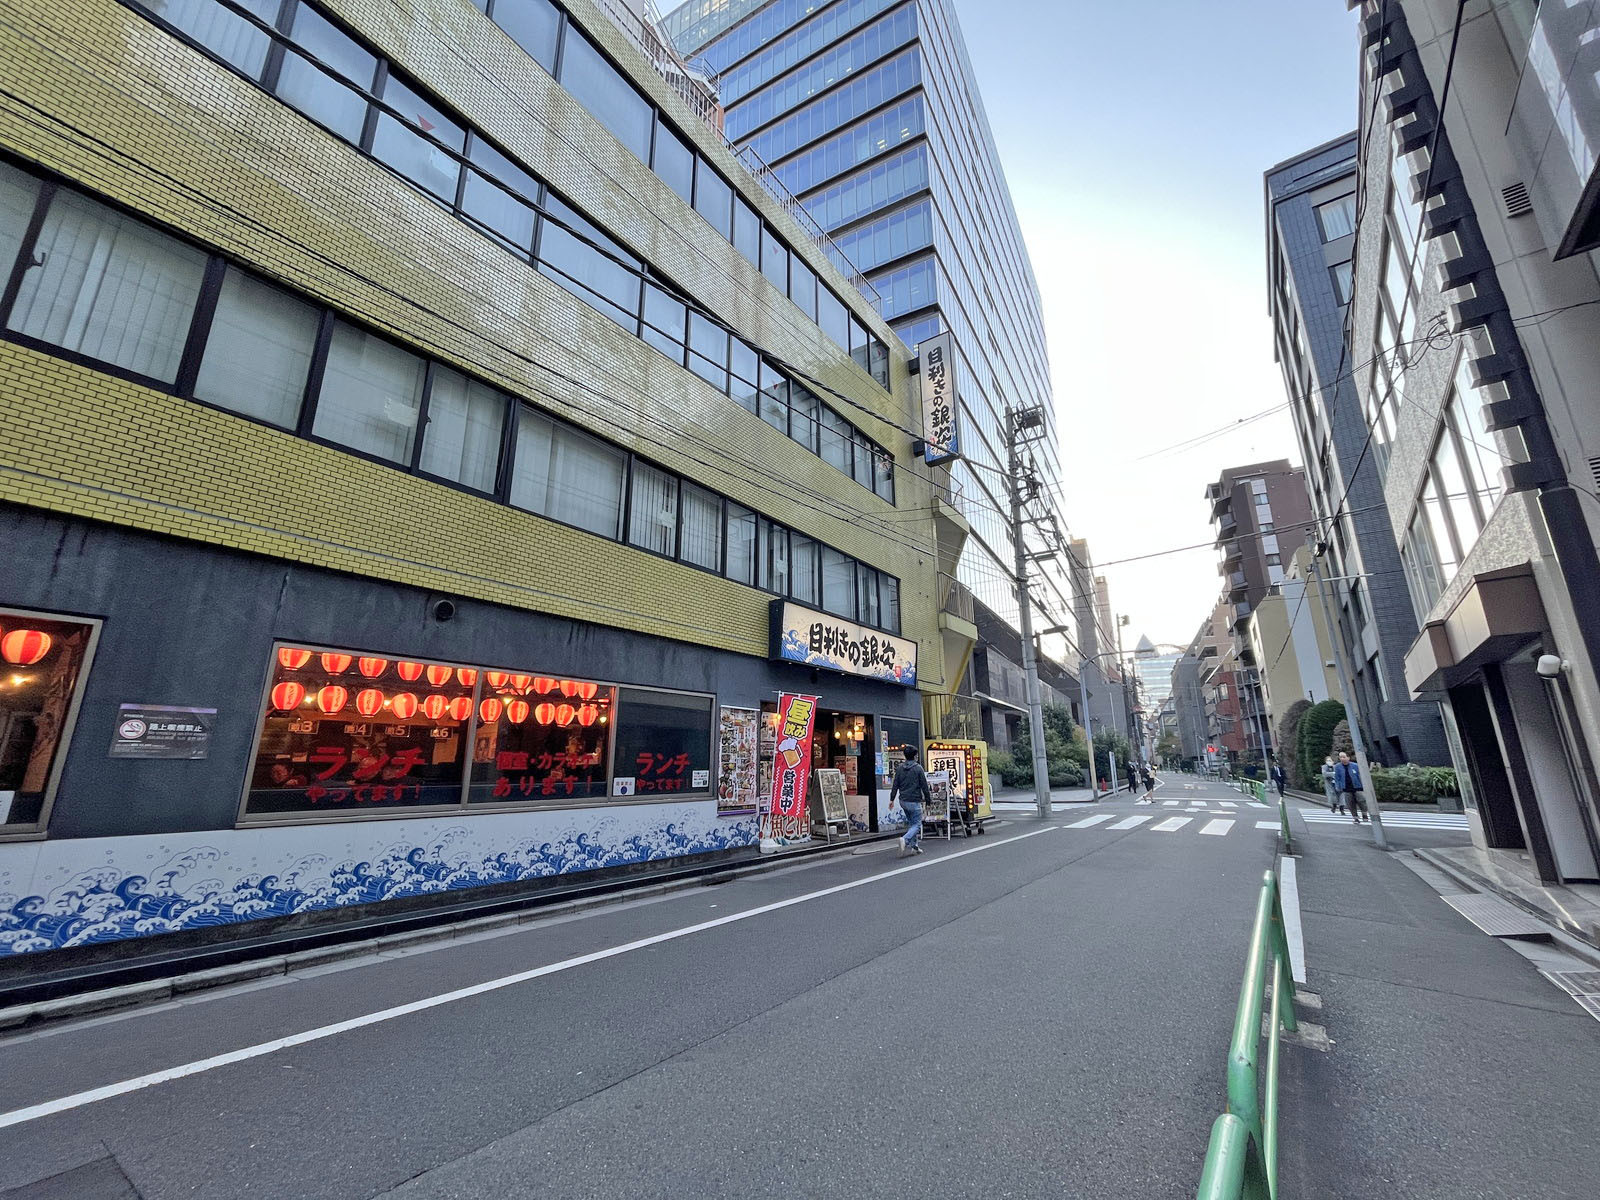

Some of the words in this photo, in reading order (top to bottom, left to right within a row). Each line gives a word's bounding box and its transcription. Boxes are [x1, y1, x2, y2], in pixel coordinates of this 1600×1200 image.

[928, 346, 952, 445] 目利きの銀次
[809, 623, 896, 670] 目利きの銀次
[310, 746, 426, 781] ランチ
[636, 752, 691, 775] ランチ
[780, 770, 796, 814] 営業中
